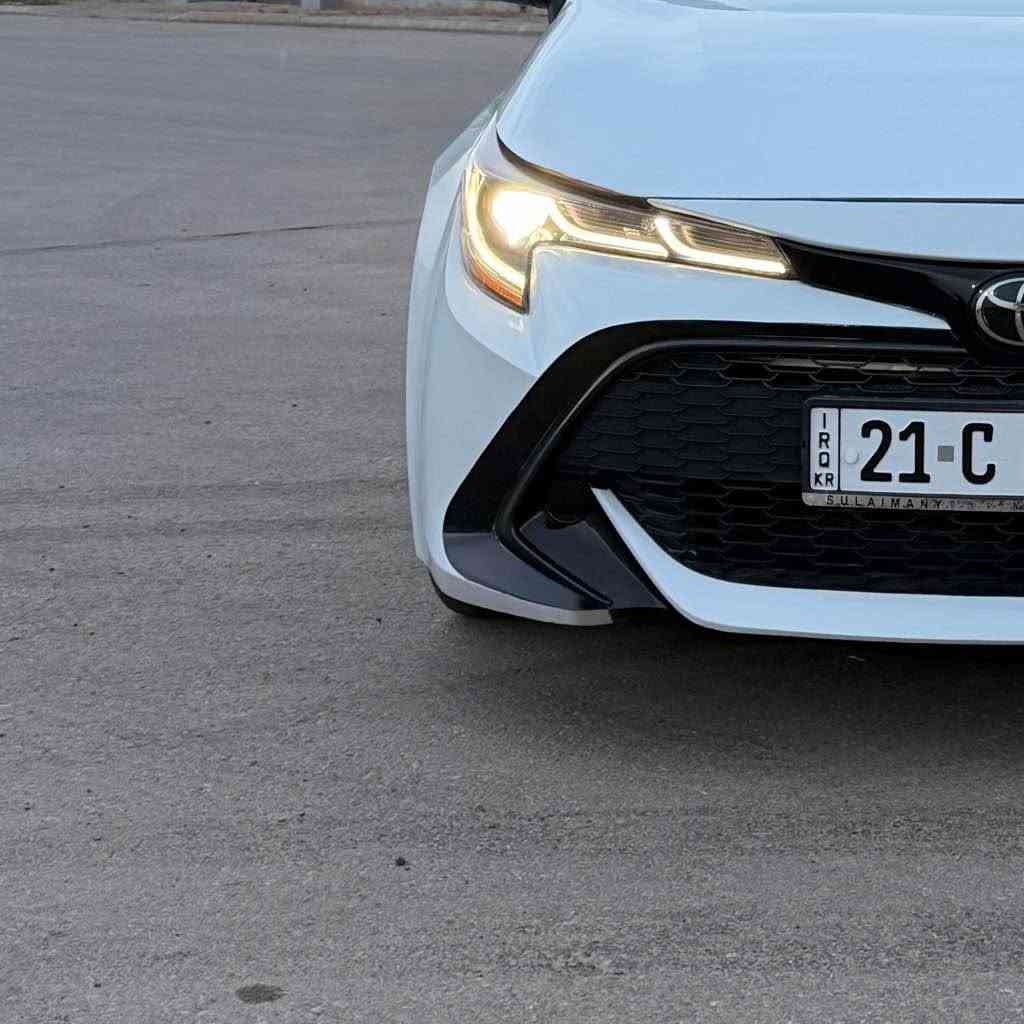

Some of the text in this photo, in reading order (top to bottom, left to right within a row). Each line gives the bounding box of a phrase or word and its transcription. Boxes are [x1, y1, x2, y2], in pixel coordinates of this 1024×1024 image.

[860, 420, 931, 483] 21
[961, 423, 996, 486] C
[814, 472, 834, 487] KR
[826, 495, 943, 510] SULAIMANY
